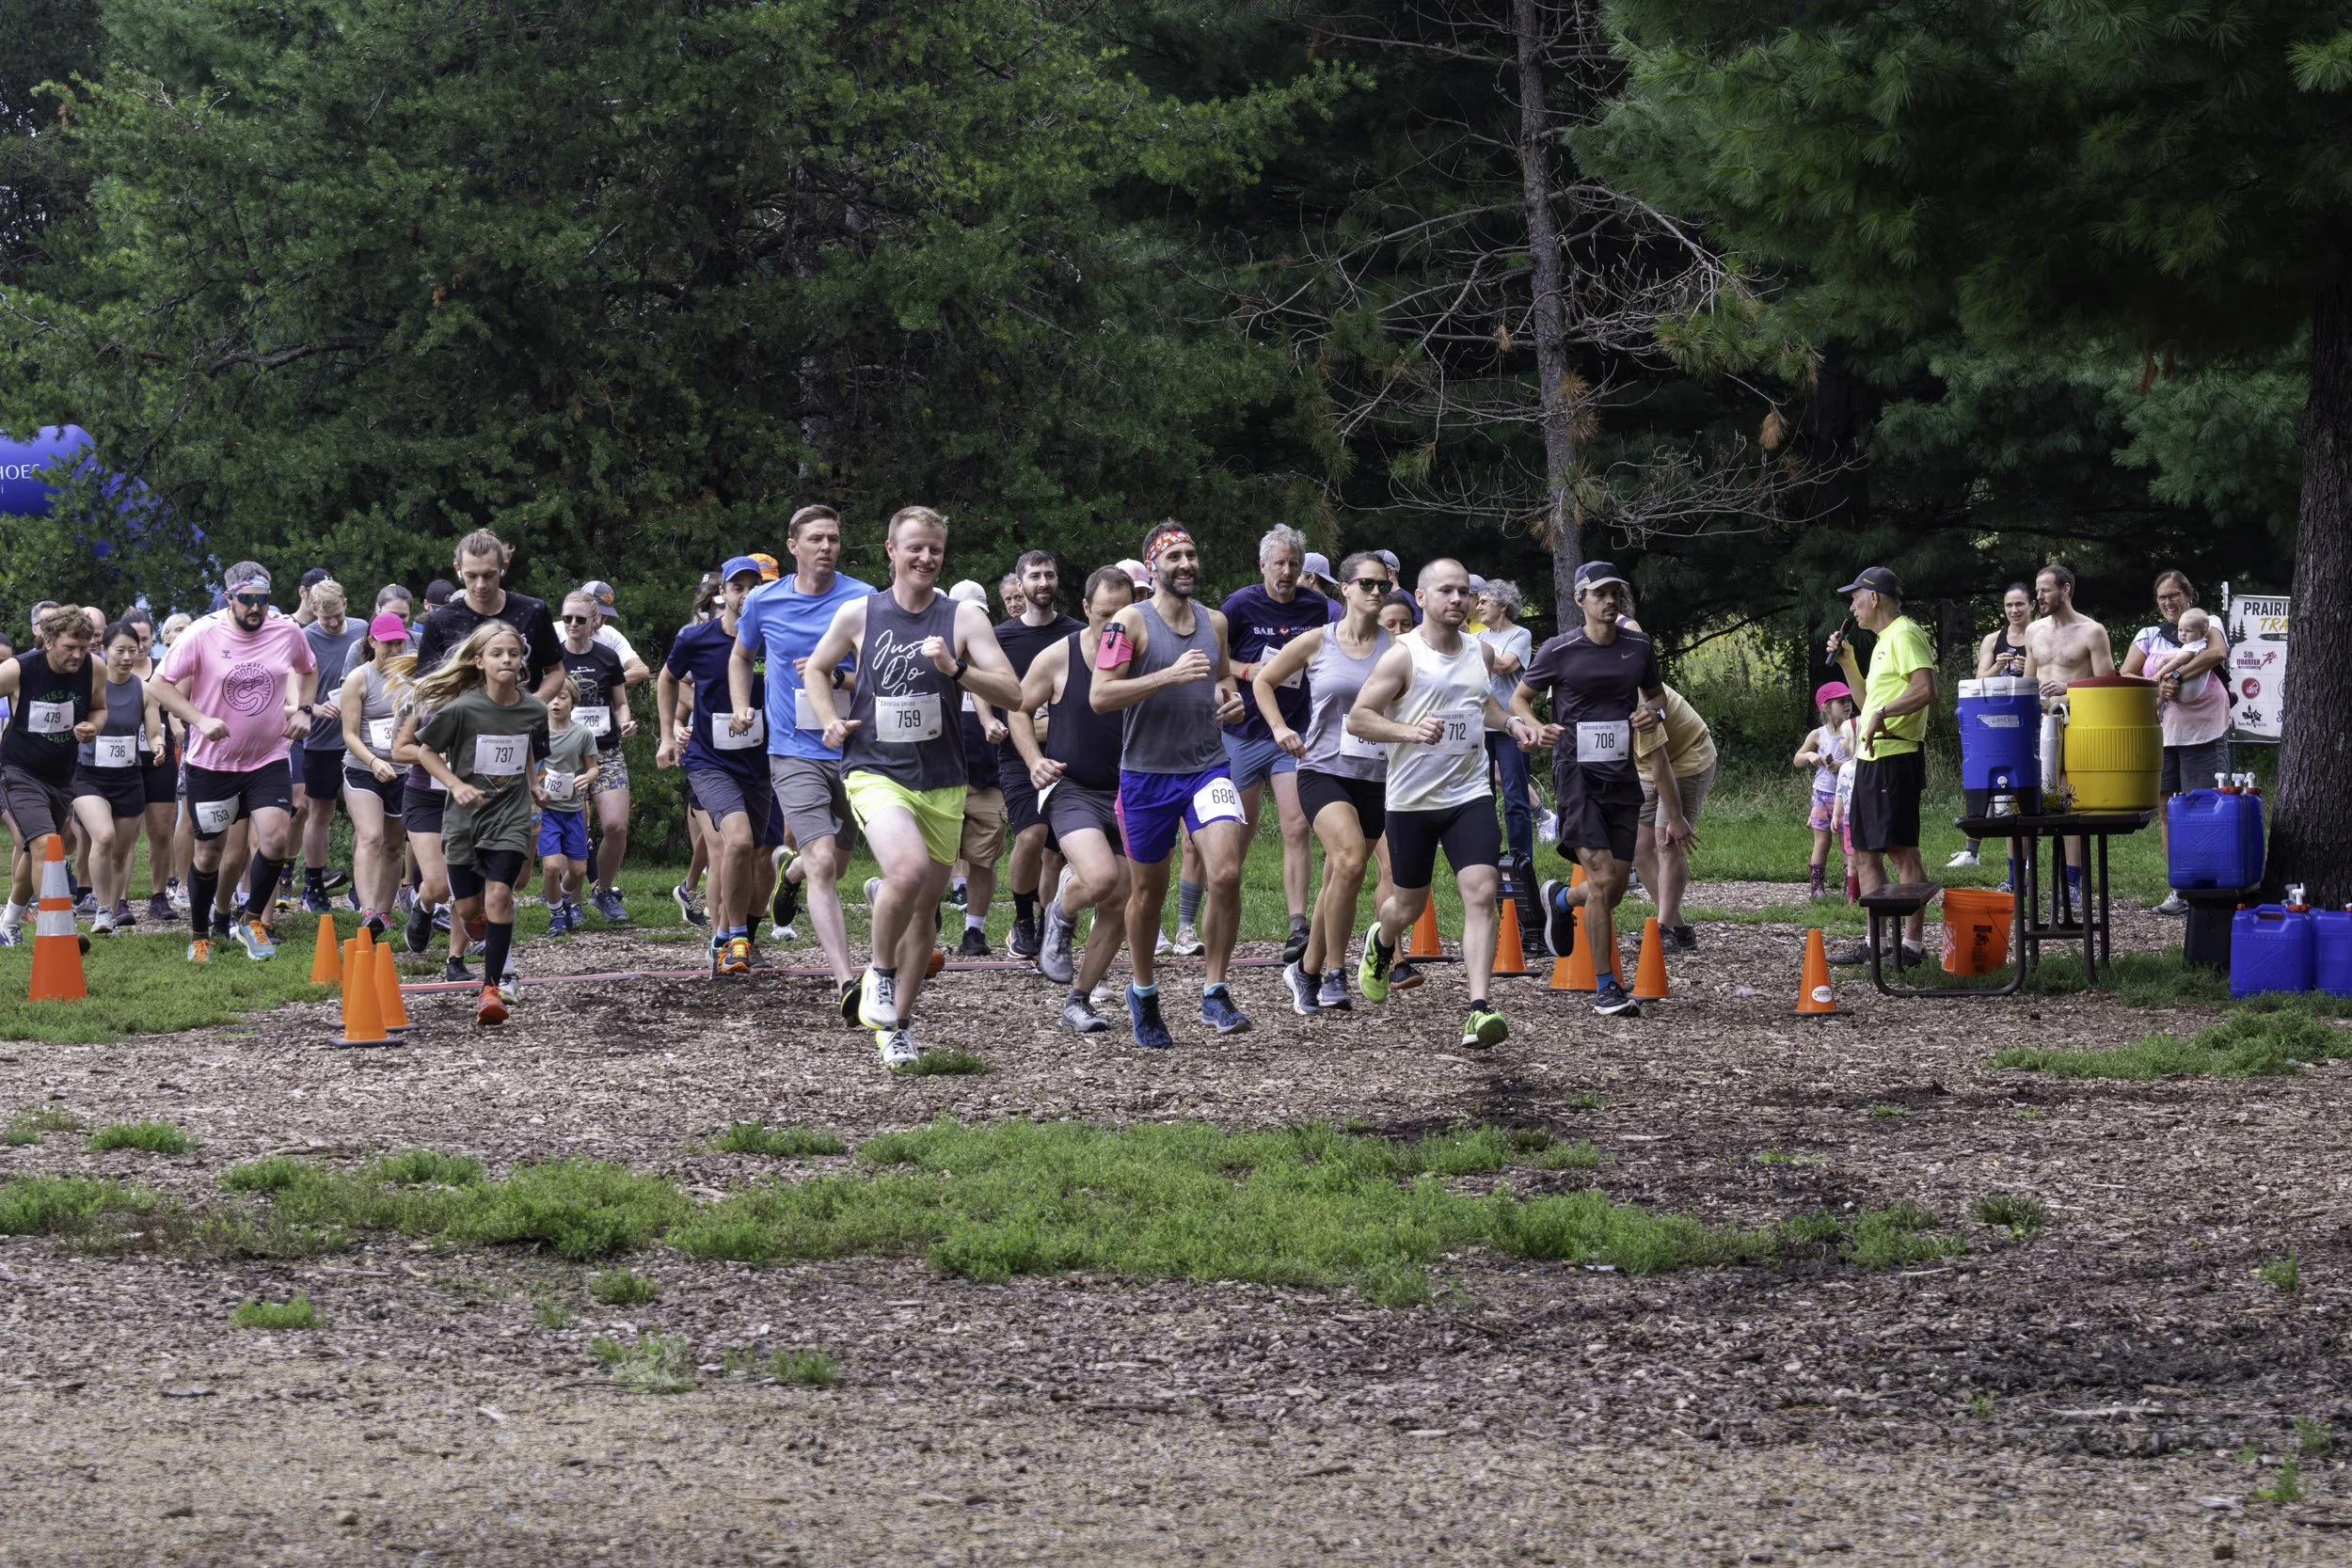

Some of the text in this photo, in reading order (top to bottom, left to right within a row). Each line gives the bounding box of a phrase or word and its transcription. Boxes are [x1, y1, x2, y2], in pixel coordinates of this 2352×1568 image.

[2243, 601, 2288, 616] PRAIRI
[1253, 626, 1276, 636] SAIL
[2259, 617, 2288, 632] TRA
[881, 655, 926, 689] Do
[43, 711, 61, 724] 479
[897, 709, 921, 729] 759
[1449, 722, 1467, 741] 712
[1595, 732, 1614, 750] 708
[109, 745, 126, 758] 736
[495, 746, 514, 764] 737
[546, 778, 563, 793] 762
[1212, 788, 1236, 805] 688
[210, 809, 230, 824] 753
